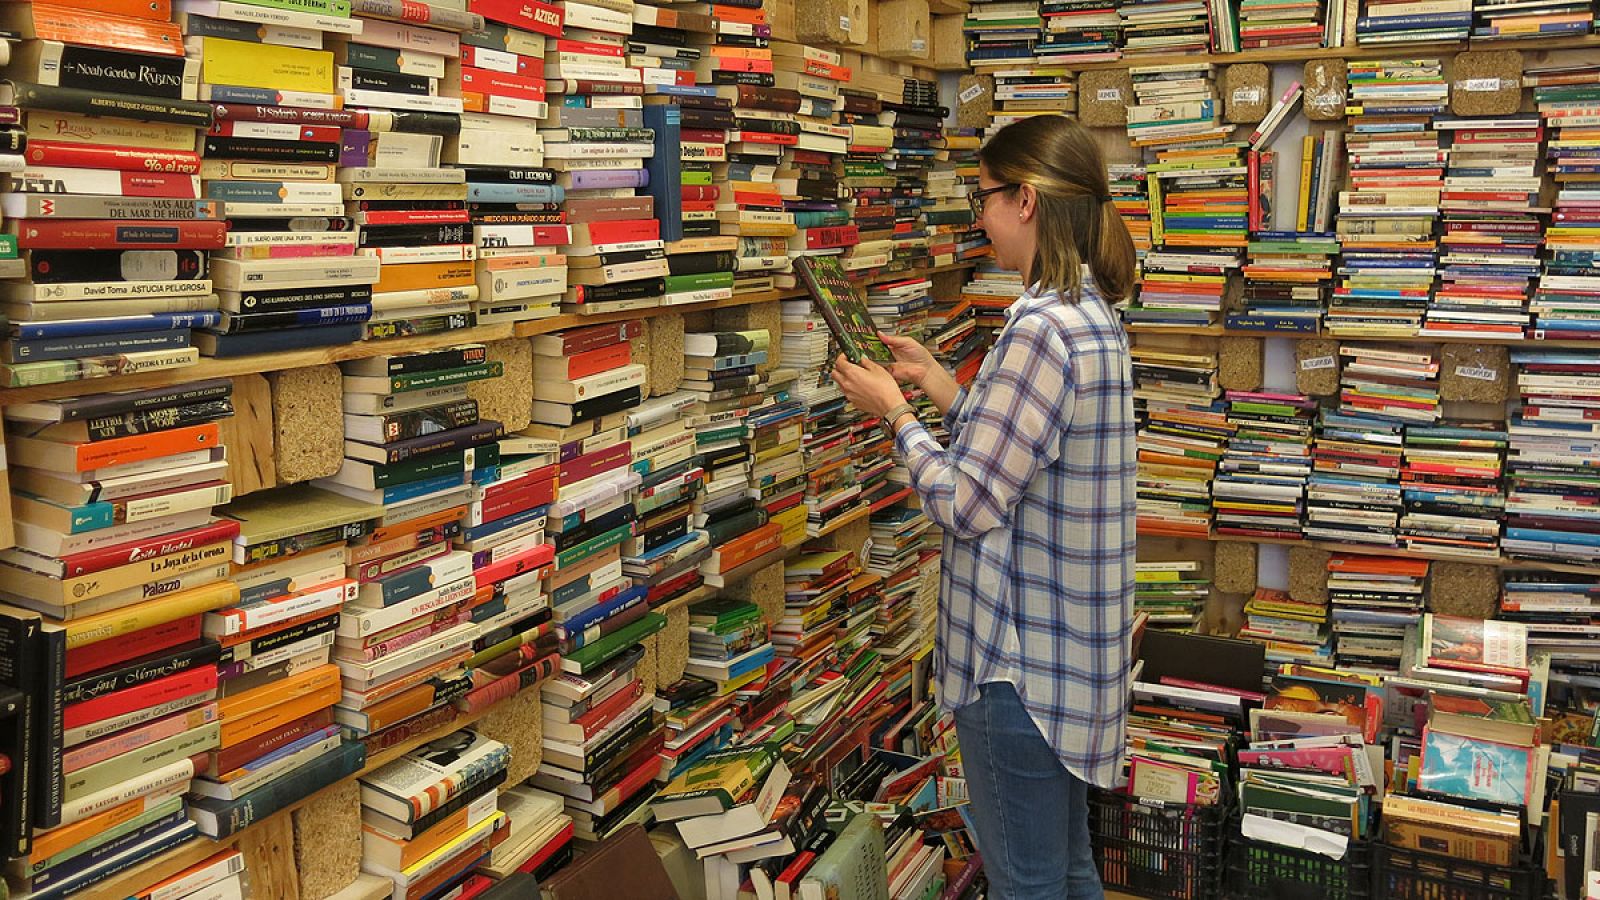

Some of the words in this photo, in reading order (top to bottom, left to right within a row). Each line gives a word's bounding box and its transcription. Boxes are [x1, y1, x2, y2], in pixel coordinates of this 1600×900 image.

[534, 9, 560, 27] AZTECA
[76, 63, 103, 77] Noah
[104, 67, 136, 80] Gordon
[139, 65, 181, 87] RABINO
[91, 98, 117, 107] ALBERTO
[144, 159, 164, 172] Yo,
[164, 161, 177, 172] el
[178, 164, 197, 174] rey
[11, 178, 67, 194] ZETA
[110, 208, 128, 218] DEL
[130, 208, 150, 218] MAR
[154, 208, 167, 218] DE
[169, 207, 194, 218] HIELO
[482, 236, 509, 247] ZETA
[84, 287, 106, 296] David
[107, 285, 128, 295] Toma
[131, 284, 164, 294] ASTUCIA
[164, 282, 206, 293] PELIGROSA
[151, 561, 161, 573] La
[162, 555, 180, 569] Joya
[181, 552, 191, 565] de
[191, 550, 199, 562] la
[199, 547, 225, 560] Corona
[143, 579, 181, 598] Palazzo
[53, 688, 61, 740] MANFREDI
[51, 746, 61, 811] ALEXANDROS
[78, 805, 94, 816] JEAN
[124, 789, 136, 798] LAS
